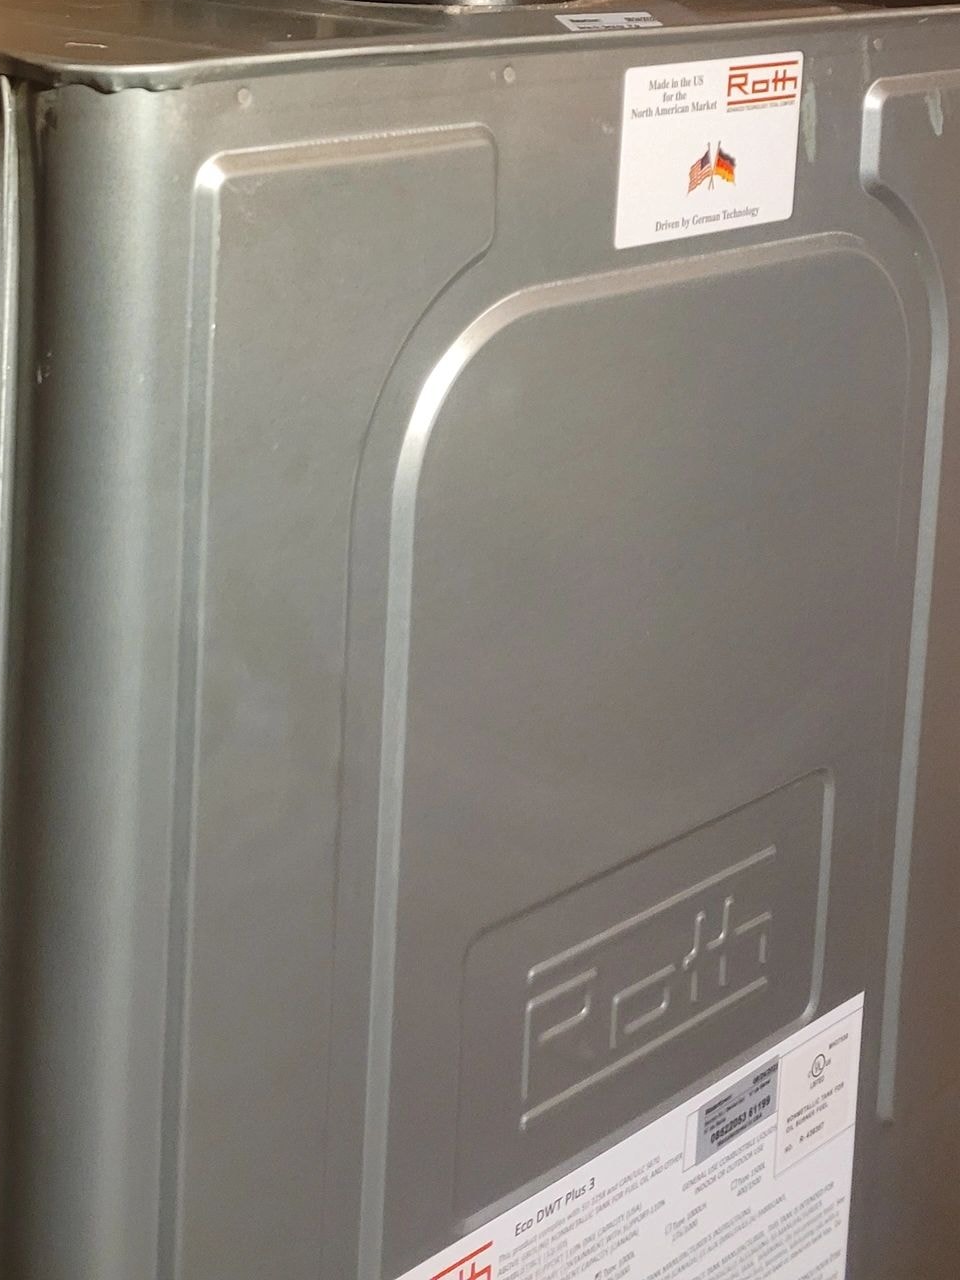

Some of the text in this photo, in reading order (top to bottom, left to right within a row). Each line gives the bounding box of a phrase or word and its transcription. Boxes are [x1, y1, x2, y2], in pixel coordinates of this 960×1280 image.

[648, 75, 704, 91] Made in the US
[727, 69, 798, 97] Roth
[662, 91, 687, 103] for the
[631, 100, 718, 119] North American Market
[655, 206, 760, 232] Driven by German Technology
[514, 1176, 595, 1236] Eco DWT Plus 3
